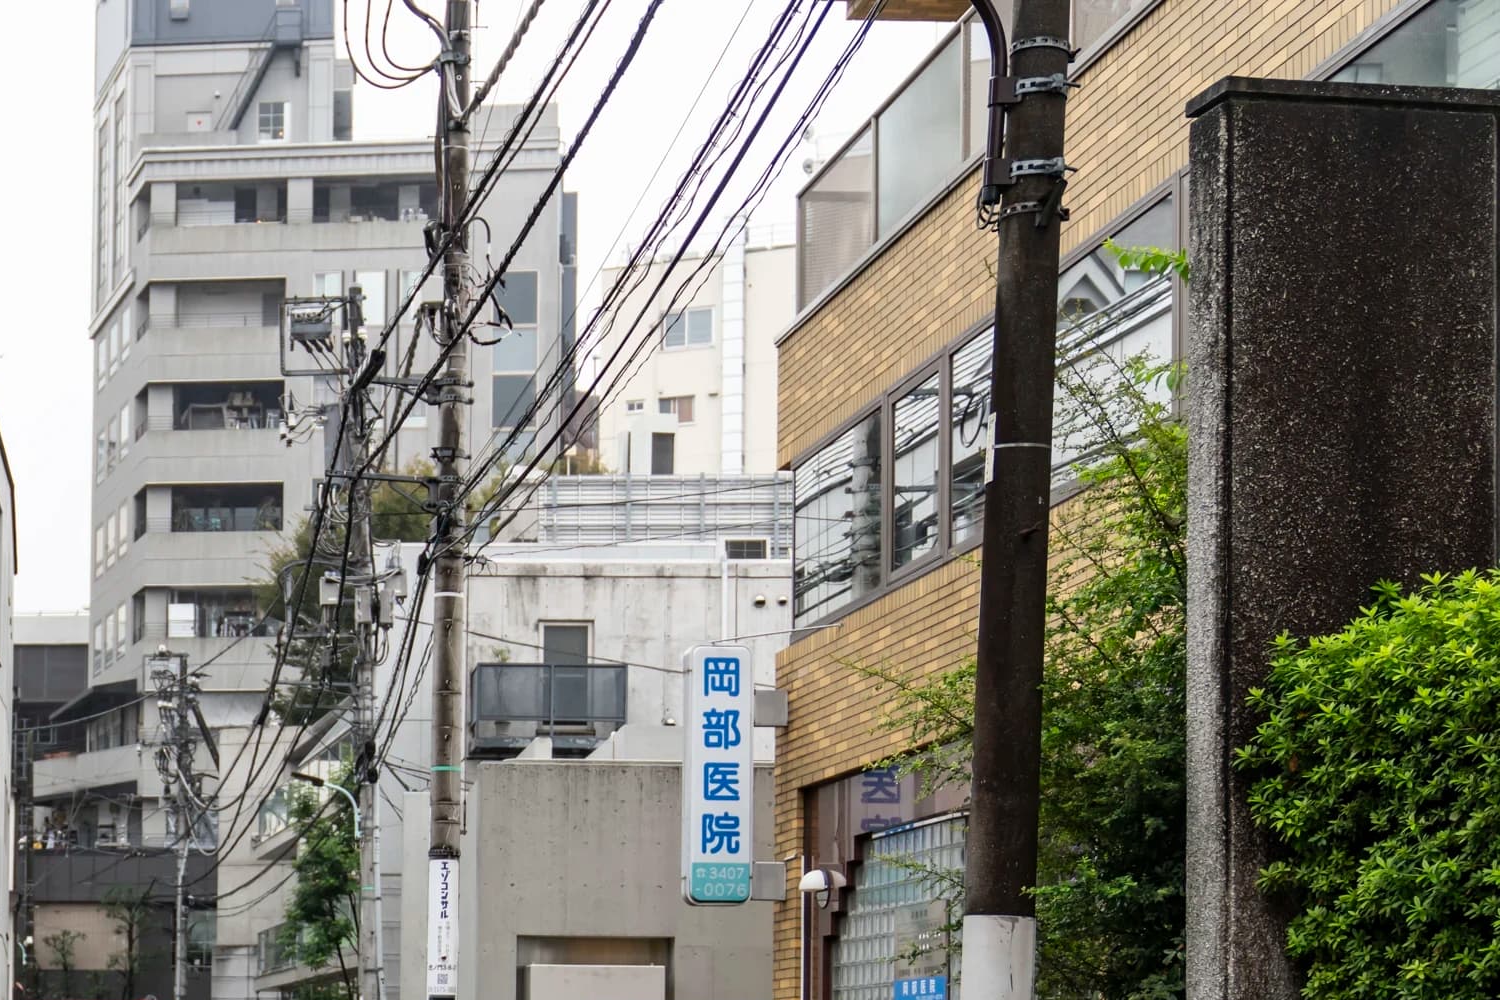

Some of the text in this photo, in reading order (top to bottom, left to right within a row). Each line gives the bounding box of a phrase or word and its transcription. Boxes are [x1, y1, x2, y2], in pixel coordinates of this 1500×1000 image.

[701, 656, 742, 855] 岡部医院
[708, 866, 745, 880] 3407
